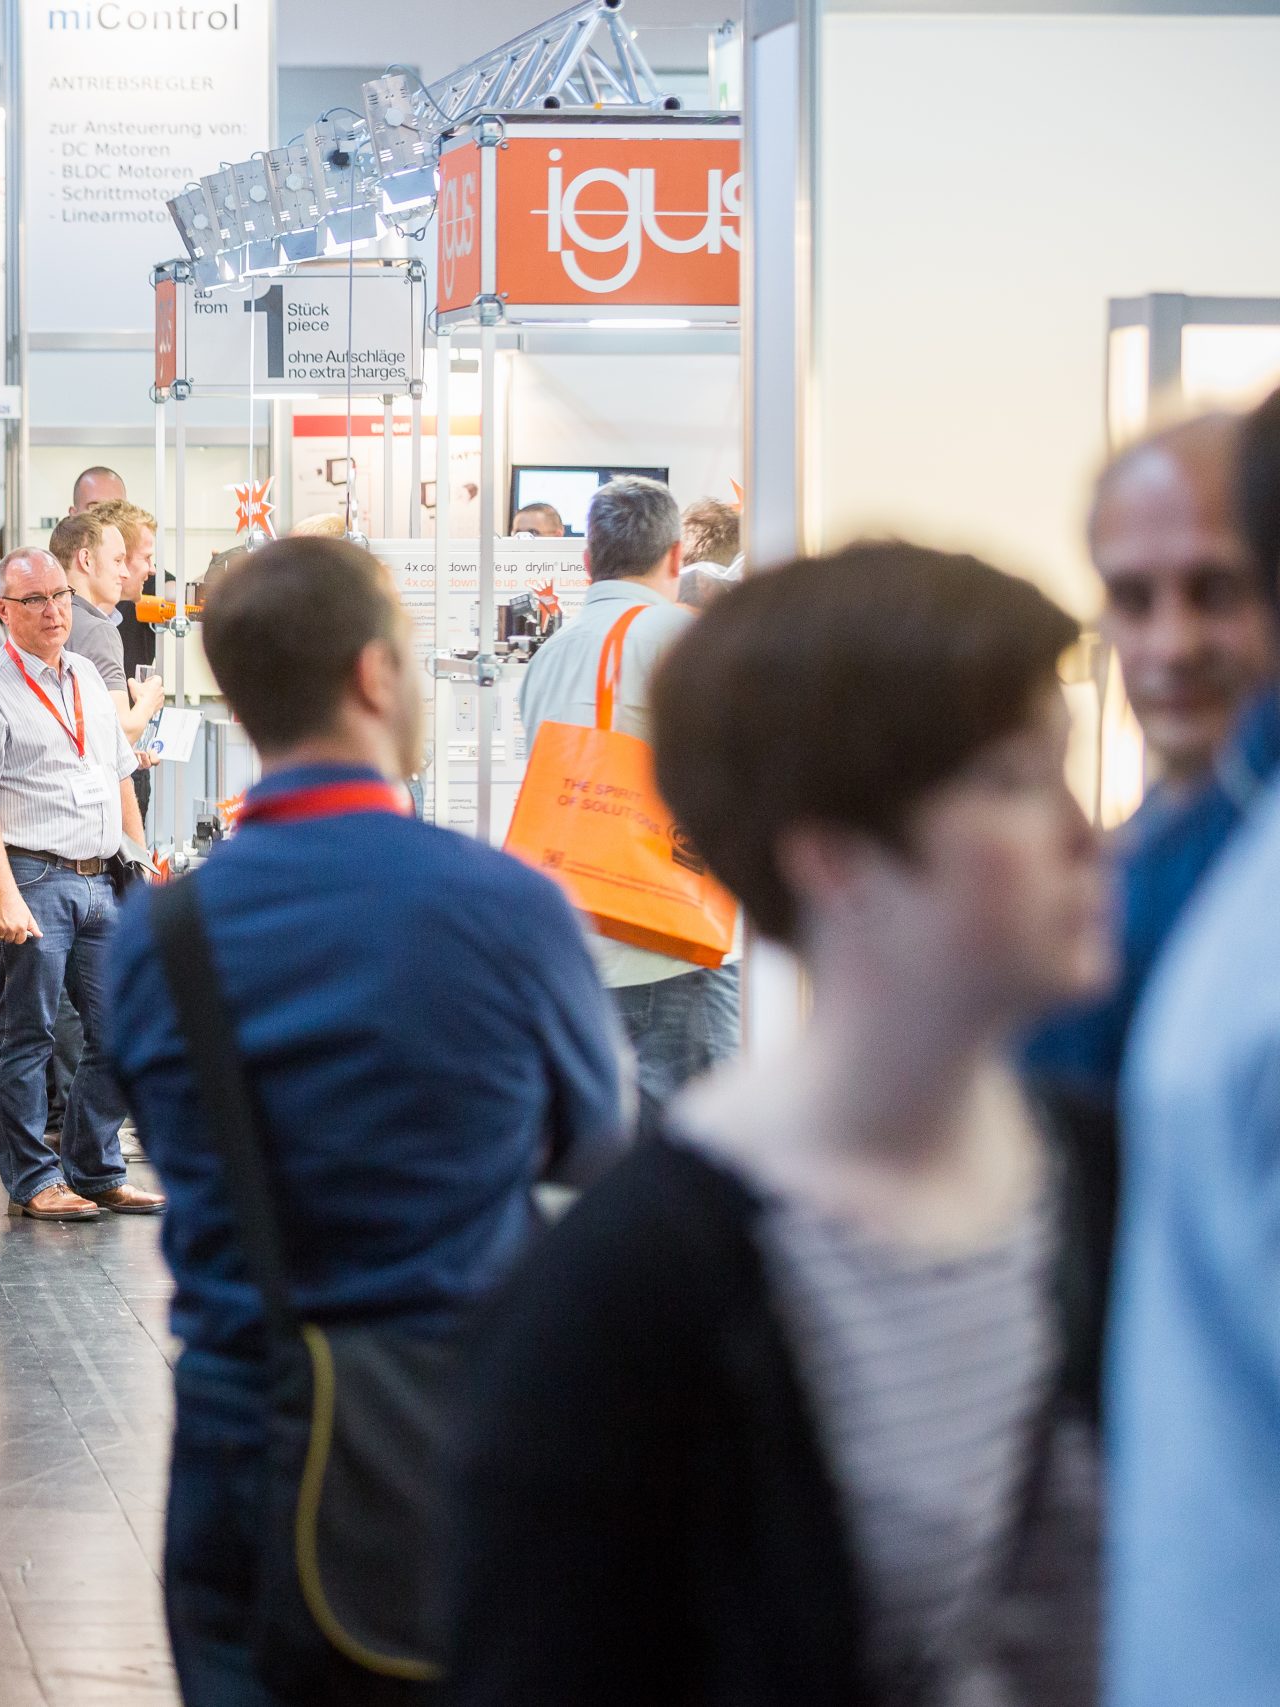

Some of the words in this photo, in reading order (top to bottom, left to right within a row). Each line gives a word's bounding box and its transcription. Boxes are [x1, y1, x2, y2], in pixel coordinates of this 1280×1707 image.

[48, 2, 239, 30] miControl
[49, 76, 214, 91] ANTRIEBSREGLER
[49, 123, 76, 135] zur
[84, 121, 202, 138] Ansteuerung
[209, 123, 247, 136] von:
[62, 143, 88, 157] DC
[95, 143, 170, 157] Motoren
[62, 165, 111, 178] BLDC
[119, 165, 193, 178] Motoren
[442, 165, 476, 300] igus
[194, 301, 228, 314] from
[288, 303, 329, 316] Stück
[244, 285, 284, 378] 1
[288, 318, 329, 334] piece
[288, 350, 323, 363] ohne
[326, 349, 405, 366] Aufschläge
[288, 368, 308, 378] no
[309, 366, 346, 378] extra
[349, 366, 405, 381] charges
[504, 564, 518, 574] up
[563, 778, 591, 793] THE
[595, 783, 641, 800] SPIRIT
[558, 795, 577, 807] OF
[581, 798, 661, 835] SOLUTIONS
